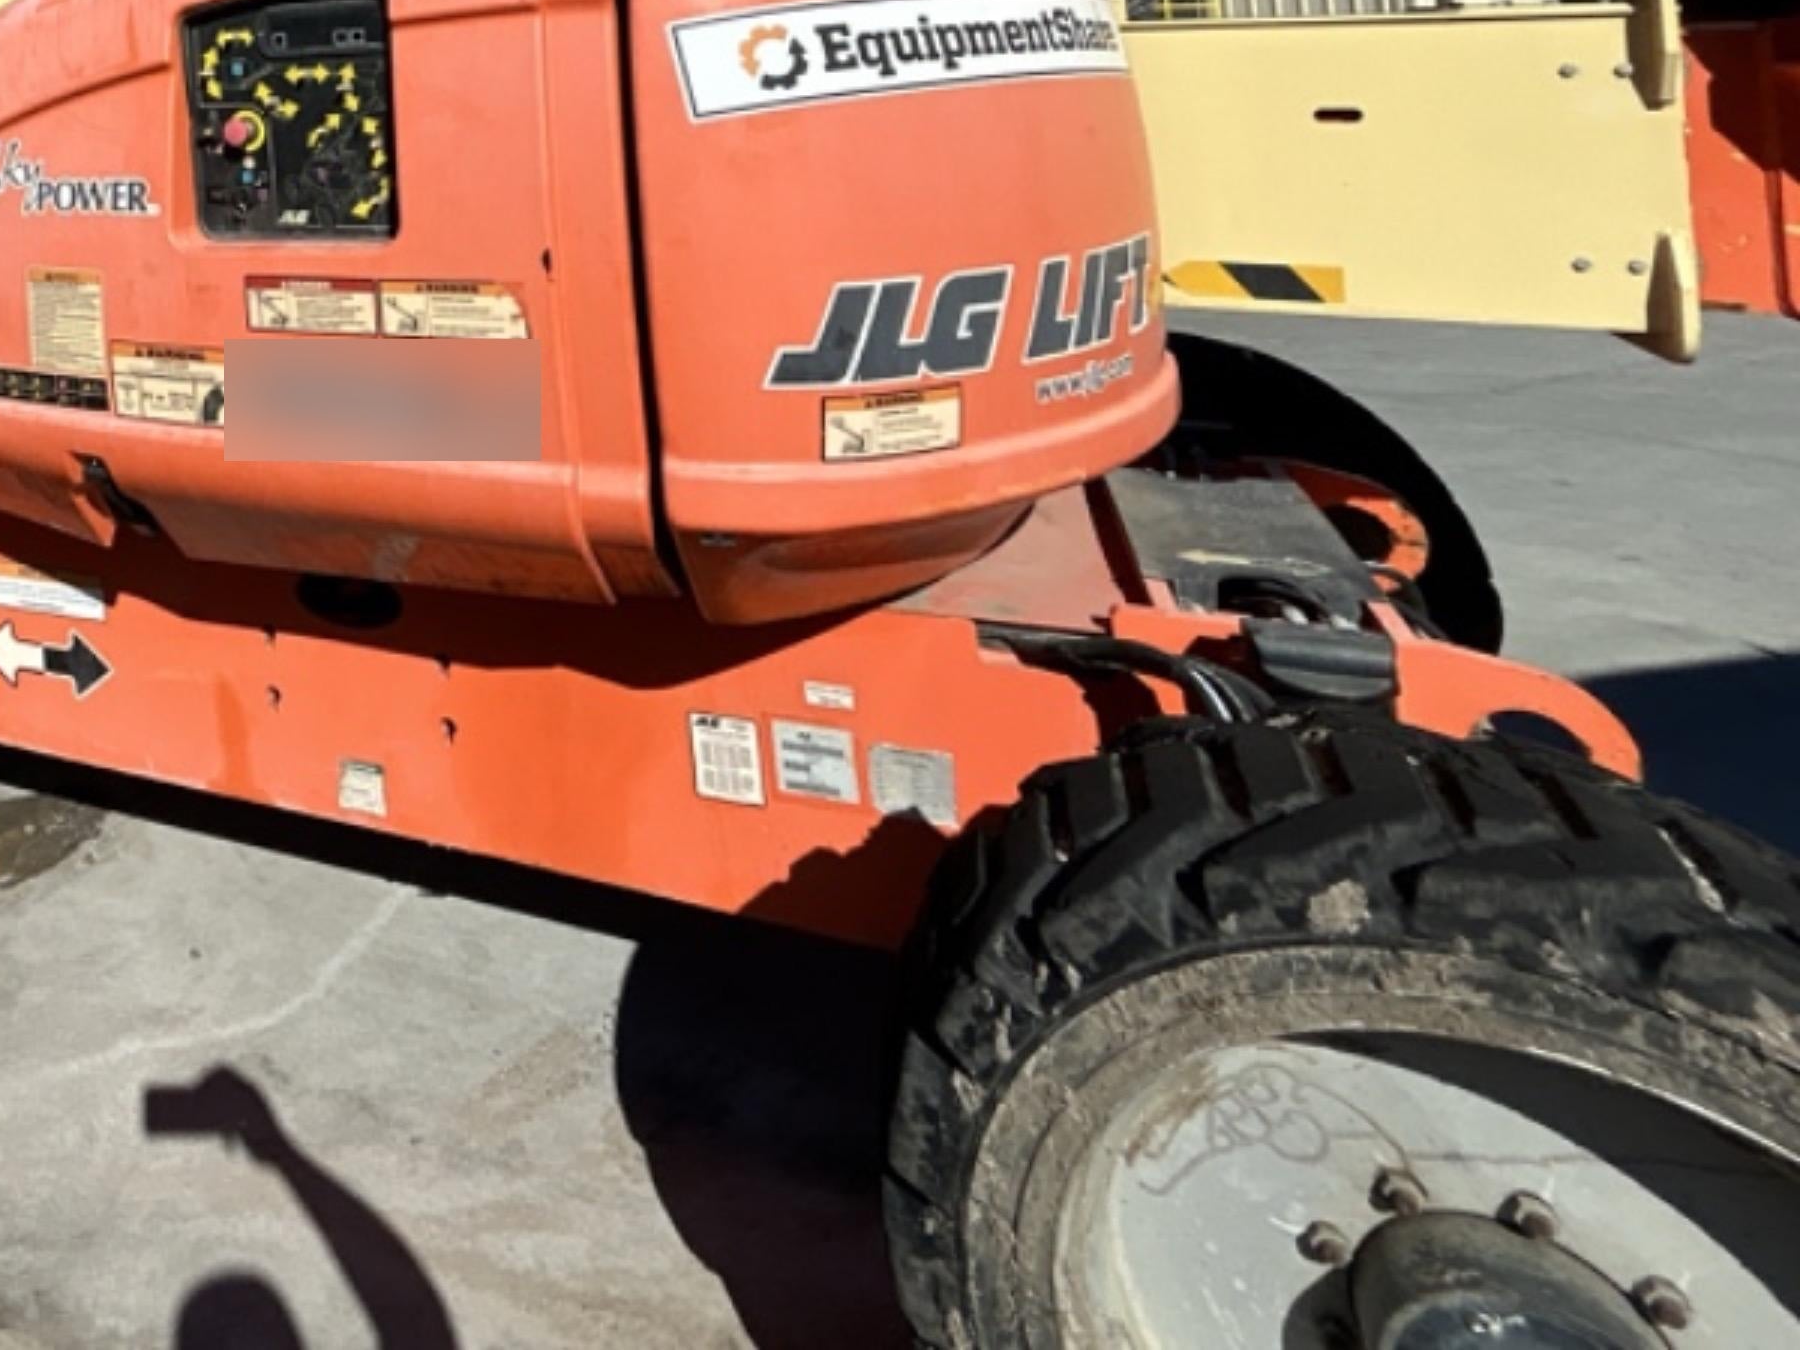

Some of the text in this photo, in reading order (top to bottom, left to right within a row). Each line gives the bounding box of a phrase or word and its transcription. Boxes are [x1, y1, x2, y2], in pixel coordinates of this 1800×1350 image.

[814, 5, 1116, 78] EquipmentShare
[36, 176, 152, 215] POWER
[762, 230, 1153, 390] JLG LIFT
